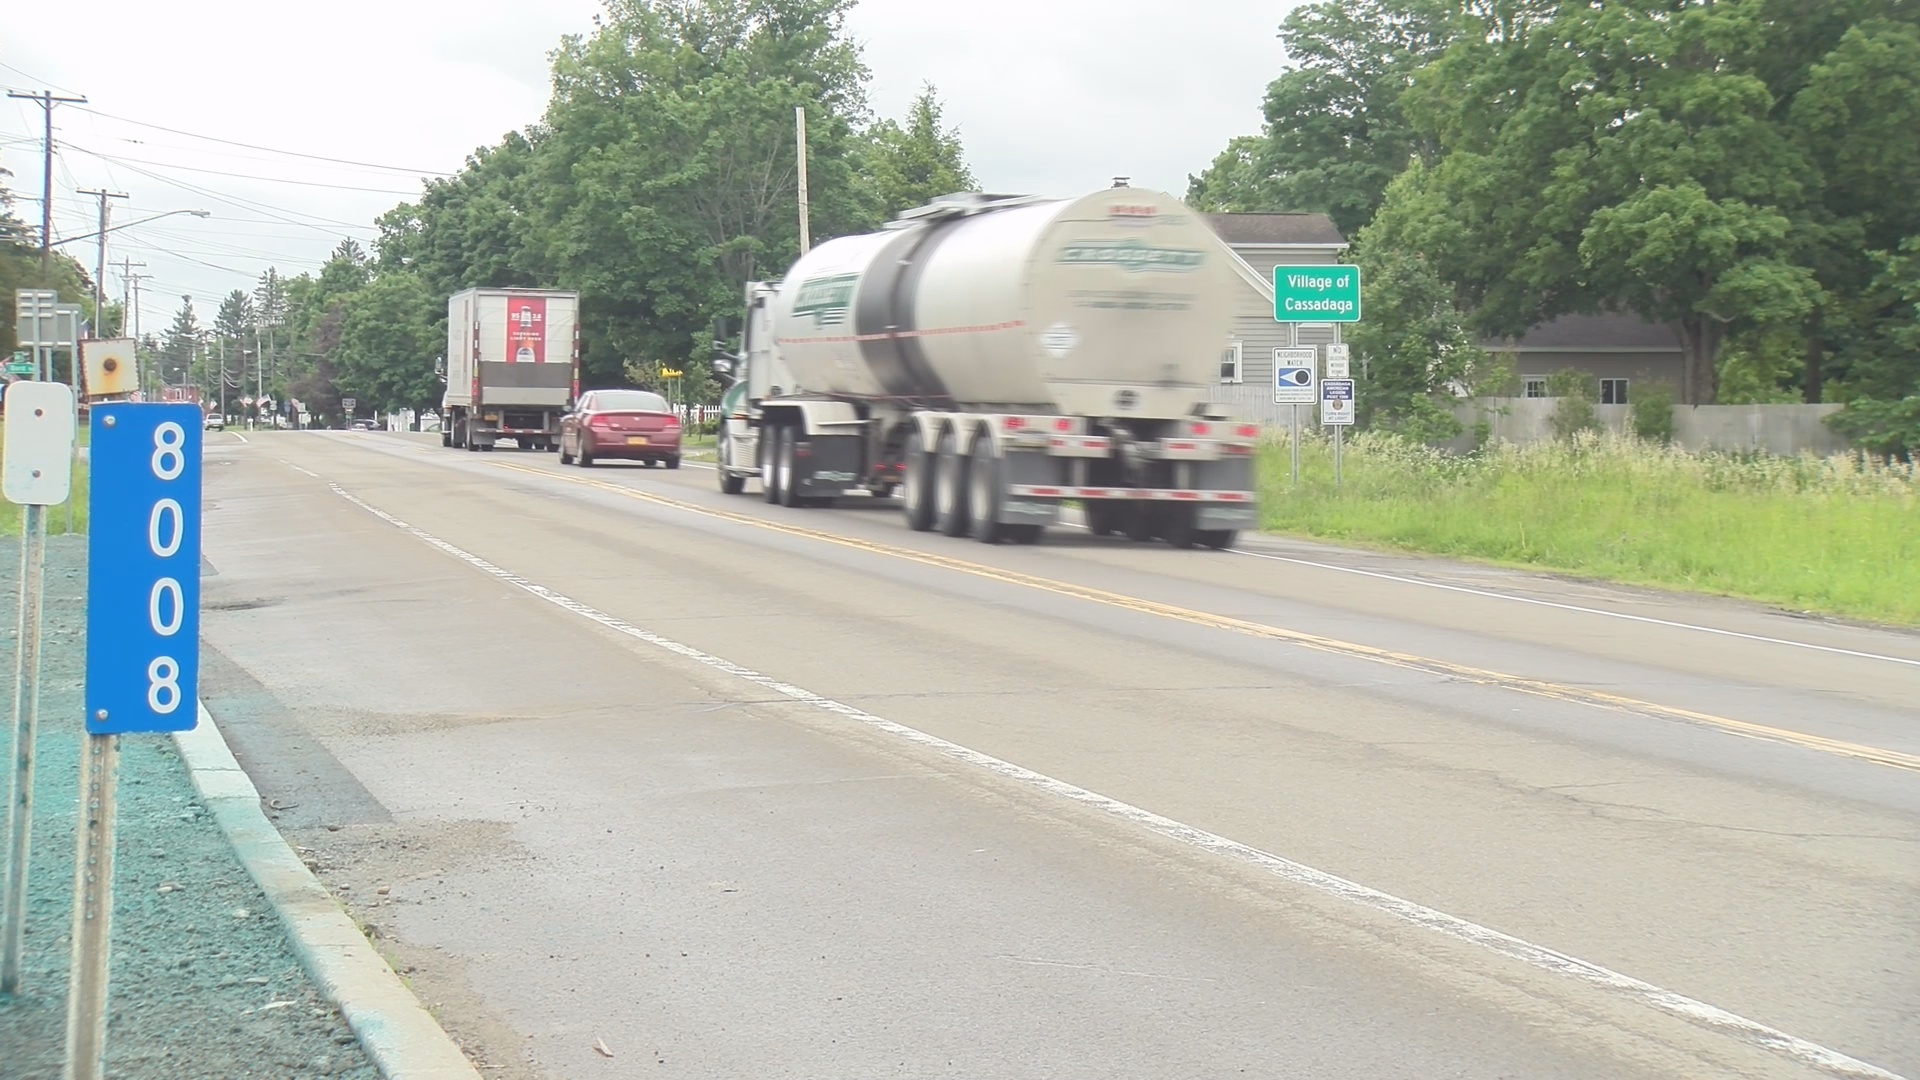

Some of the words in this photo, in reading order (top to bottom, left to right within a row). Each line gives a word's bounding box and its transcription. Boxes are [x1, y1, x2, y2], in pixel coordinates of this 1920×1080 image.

[1287, 274, 1332, 291] Village
[1336, 274, 1350, 288] of
[1285, 297, 1353, 314] Cassadaga
[148, 421, 186, 714] 8008
